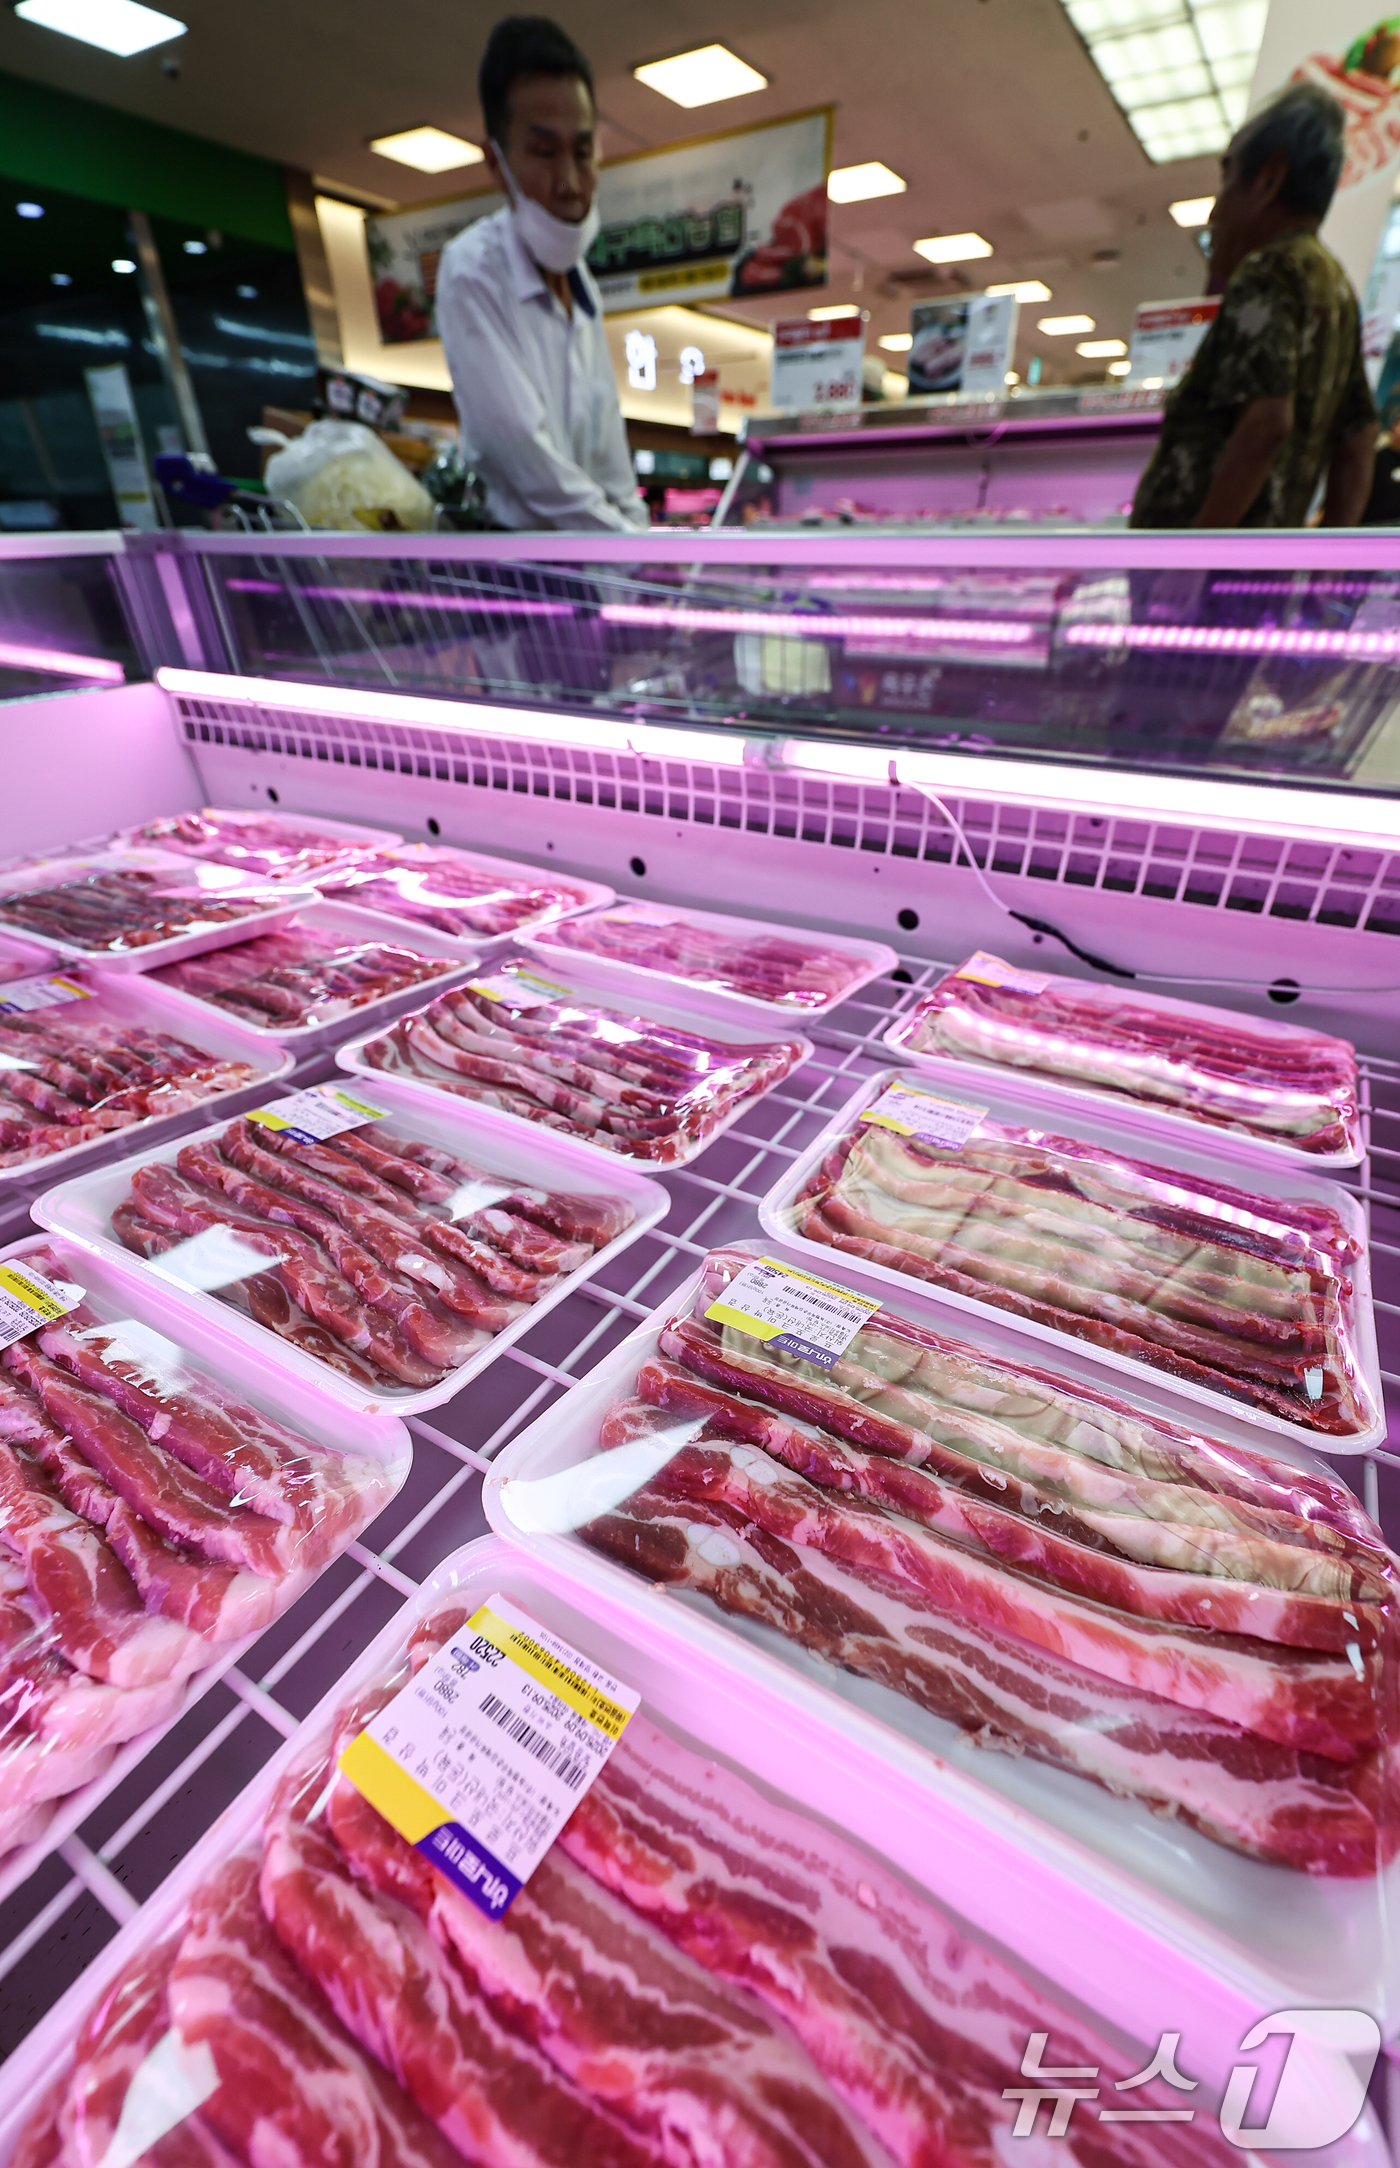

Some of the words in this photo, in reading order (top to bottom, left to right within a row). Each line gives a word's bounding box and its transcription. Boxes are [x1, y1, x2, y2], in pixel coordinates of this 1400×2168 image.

[748, 1277, 768, 1288] 2880
[762, 1265, 789, 1278] 24500
[774, 1334, 835, 1365] 하나로마트
[467, 1634, 507, 1669] 22520
[449, 1658, 473, 1680] 782
[431, 1677, 461, 1704] 2880
[519, 1683, 565, 1722] 2025.09.13
[562, 1717, 609, 1758] 2025.09.09
[426, 1823, 513, 1914] 하나로마트
